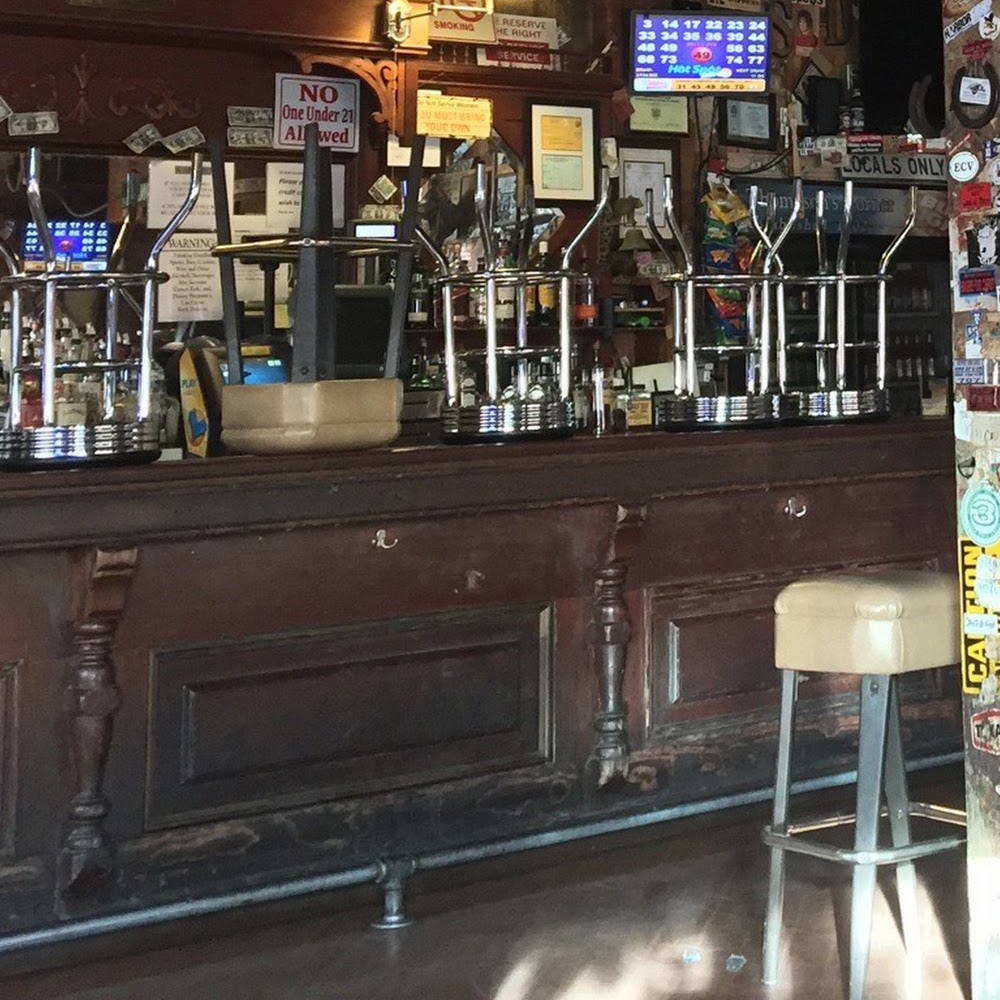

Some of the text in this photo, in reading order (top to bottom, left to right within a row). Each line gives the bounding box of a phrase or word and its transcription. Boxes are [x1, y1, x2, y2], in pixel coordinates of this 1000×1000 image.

[433, 19, 475, 32] SMOKING
[503, 18, 546, 30] RESERVE
[643, 20, 766, 30] 3 14 17 22 23 24
[496, 28, 542, 39] HE RIGHT
[638, 31, 766, 41] 33 34 35 36 39 44
[637, 42, 655, 52] 48
[660, 43, 678, 52] 49
[726, 44, 743, 53] 56
[748, 44, 765, 53] 63
[498, 52, 540, 62] SERVICE
[660, 55, 677, 64] 73
[726, 55, 743, 64] 74
[748, 56, 765, 64] 77
[693, 51, 710, 59] 49
[668, 65, 690, 74] Hot
[299, 84, 338, 103] NO
[283, 105, 353, 123] One Under 21
[285, 123, 349, 144] Alwed
[907, 156, 945, 176] ONLY
[954, 161, 974, 173] ECV
[168, 238, 215, 250] WARNING
[964, 546, 987, 682] CATION
